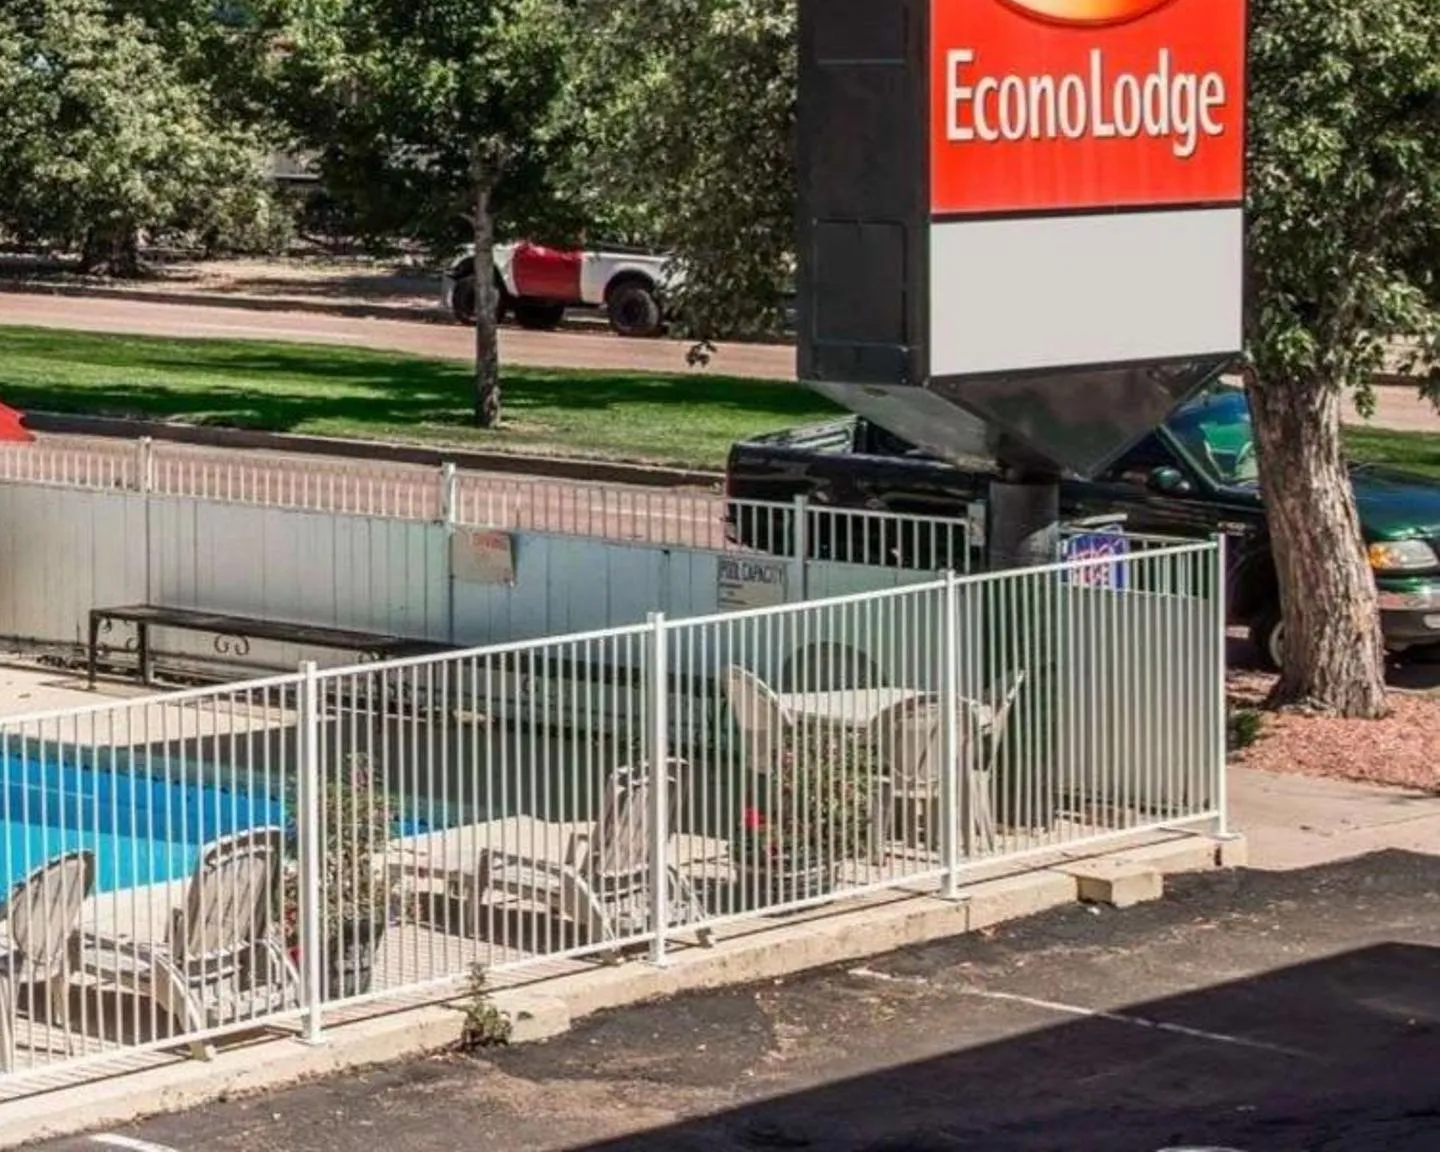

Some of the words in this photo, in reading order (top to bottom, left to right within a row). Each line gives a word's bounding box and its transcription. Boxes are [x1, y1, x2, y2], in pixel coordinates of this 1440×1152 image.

[946, 48, 1226, 157] EconoLodge
[719, 558, 741, 581] POOL
[741, 561, 784, 585] CAPACITY
